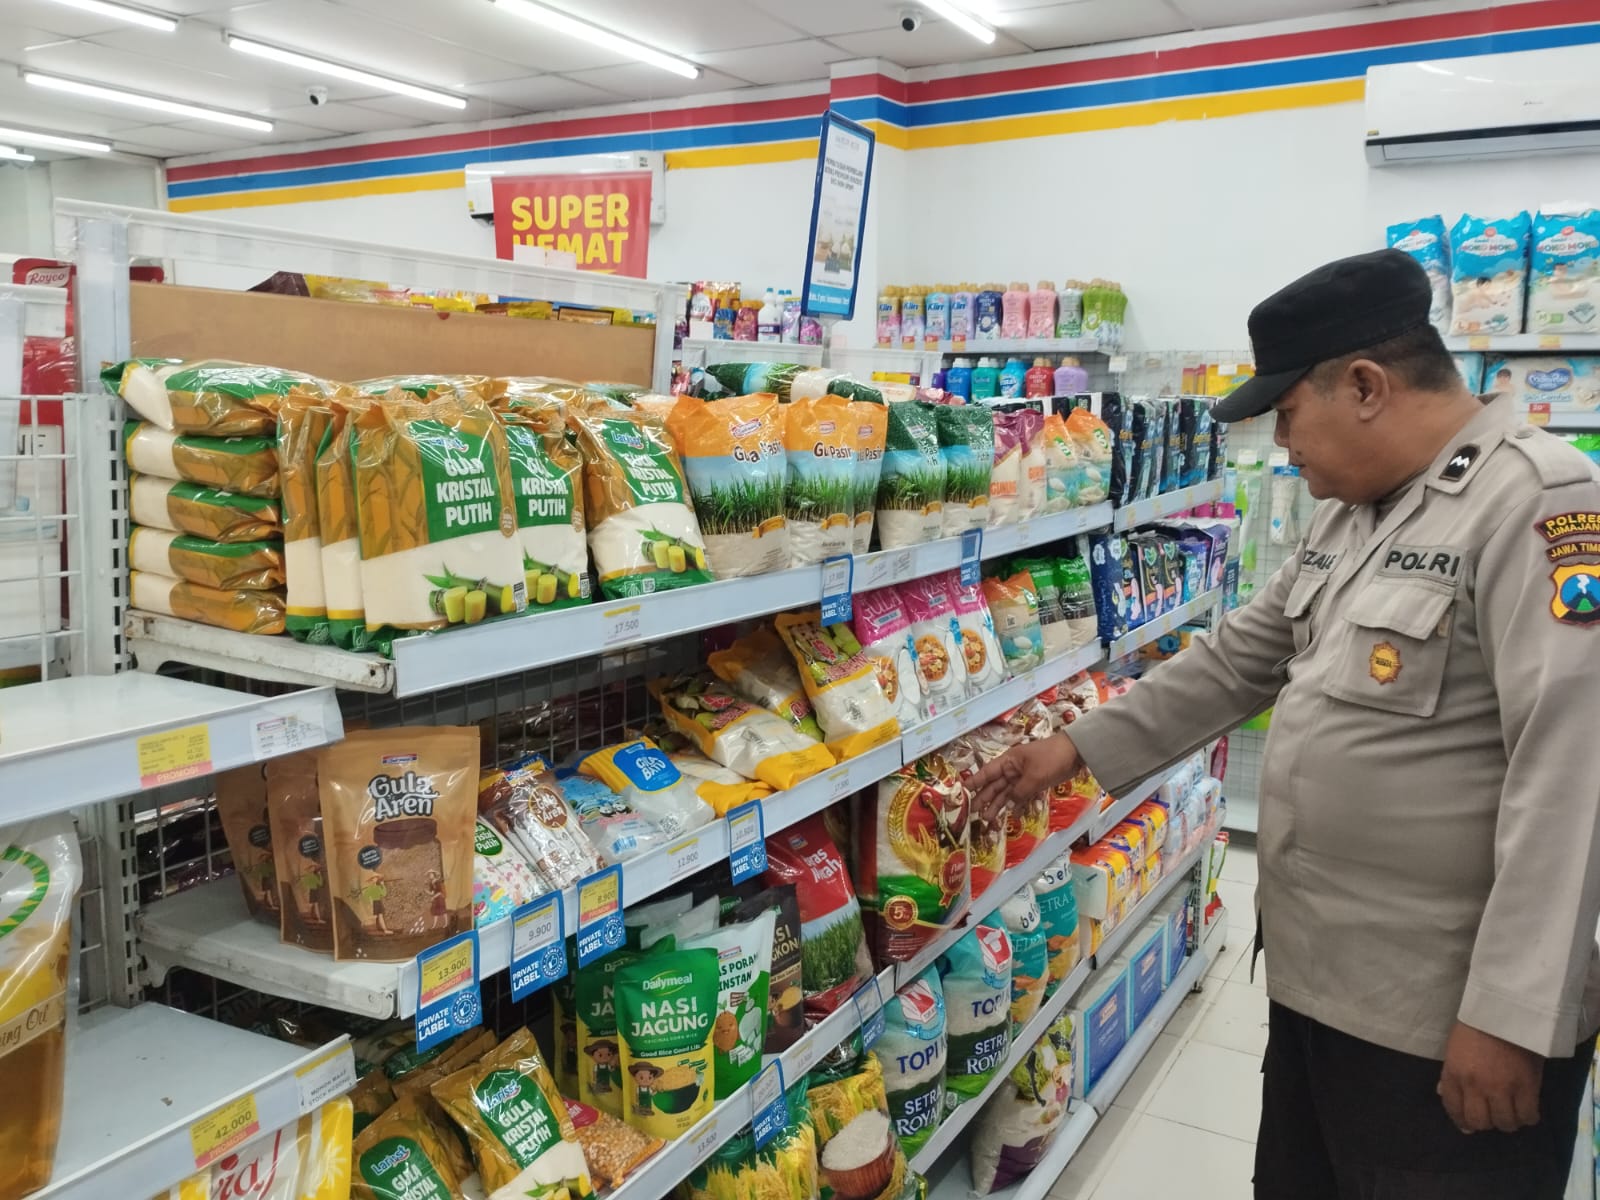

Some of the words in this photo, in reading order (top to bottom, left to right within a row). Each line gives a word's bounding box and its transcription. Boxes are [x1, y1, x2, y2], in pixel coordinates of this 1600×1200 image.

[511, 193, 630, 231] SUPER
[29, 272, 66, 285] Royco
[436, 477, 495, 503] KRISTAL
[521, 477, 568, 496] KRISTAL
[640, 481, 677, 497] PUTIH
[445, 502, 493, 527] PUTIH
[528, 499, 566, 517] PUTIH
[1547, 523, 1600, 538] LUMAJAN
[1551, 544, 1578, 557] JAWA
[1385, 551, 1460, 577] POLRI
[822, 609, 838, 619] LABEL
[369, 772, 434, 798] Gula
[376, 797, 432, 820] Aren
[476, 838, 500, 852] Putih
[733, 863, 750, 876] LABEL
[812, 858, 839, 883] Mrah
[894, 905, 904, 920] 5
[1040, 892, 1069, 914] ETRA
[528, 922, 552, 941] 9.900
[579, 930, 602, 947] PRIVATE
[580, 939, 603, 958] LABEL
[439, 958, 467, 980] 13.900
[512, 961, 540, 980] PRIVATE
[514, 970, 541, 991] LABEL
[642, 973, 693, 990] Dailymeal
[418, 1008, 449, 1029] PRIVATE
[641, 996, 698, 1019] NASI
[0, 1024, 22, 1047] ing
[26, 1003, 49, 1031] Oil
[419, 1018, 450, 1041] LABEL
[631, 1013, 708, 1037] JAGUNG
[975, 1029, 1008, 1055] SETRA
[896, 1045, 938, 1074] TOPI
[905, 1084, 943, 1115] SETRA
[500, 1099, 533, 1128] GULA
[215, 1110, 252, 1140] 42.000
[501, 1108, 548, 1146] KRISTAL
[755, 1123, 772, 1142] LABEL
[515, 1126, 552, 1158] PUTIH
[392, 1164, 423, 1191] GULA
[400, 1176, 438, 1200] RISTAL
